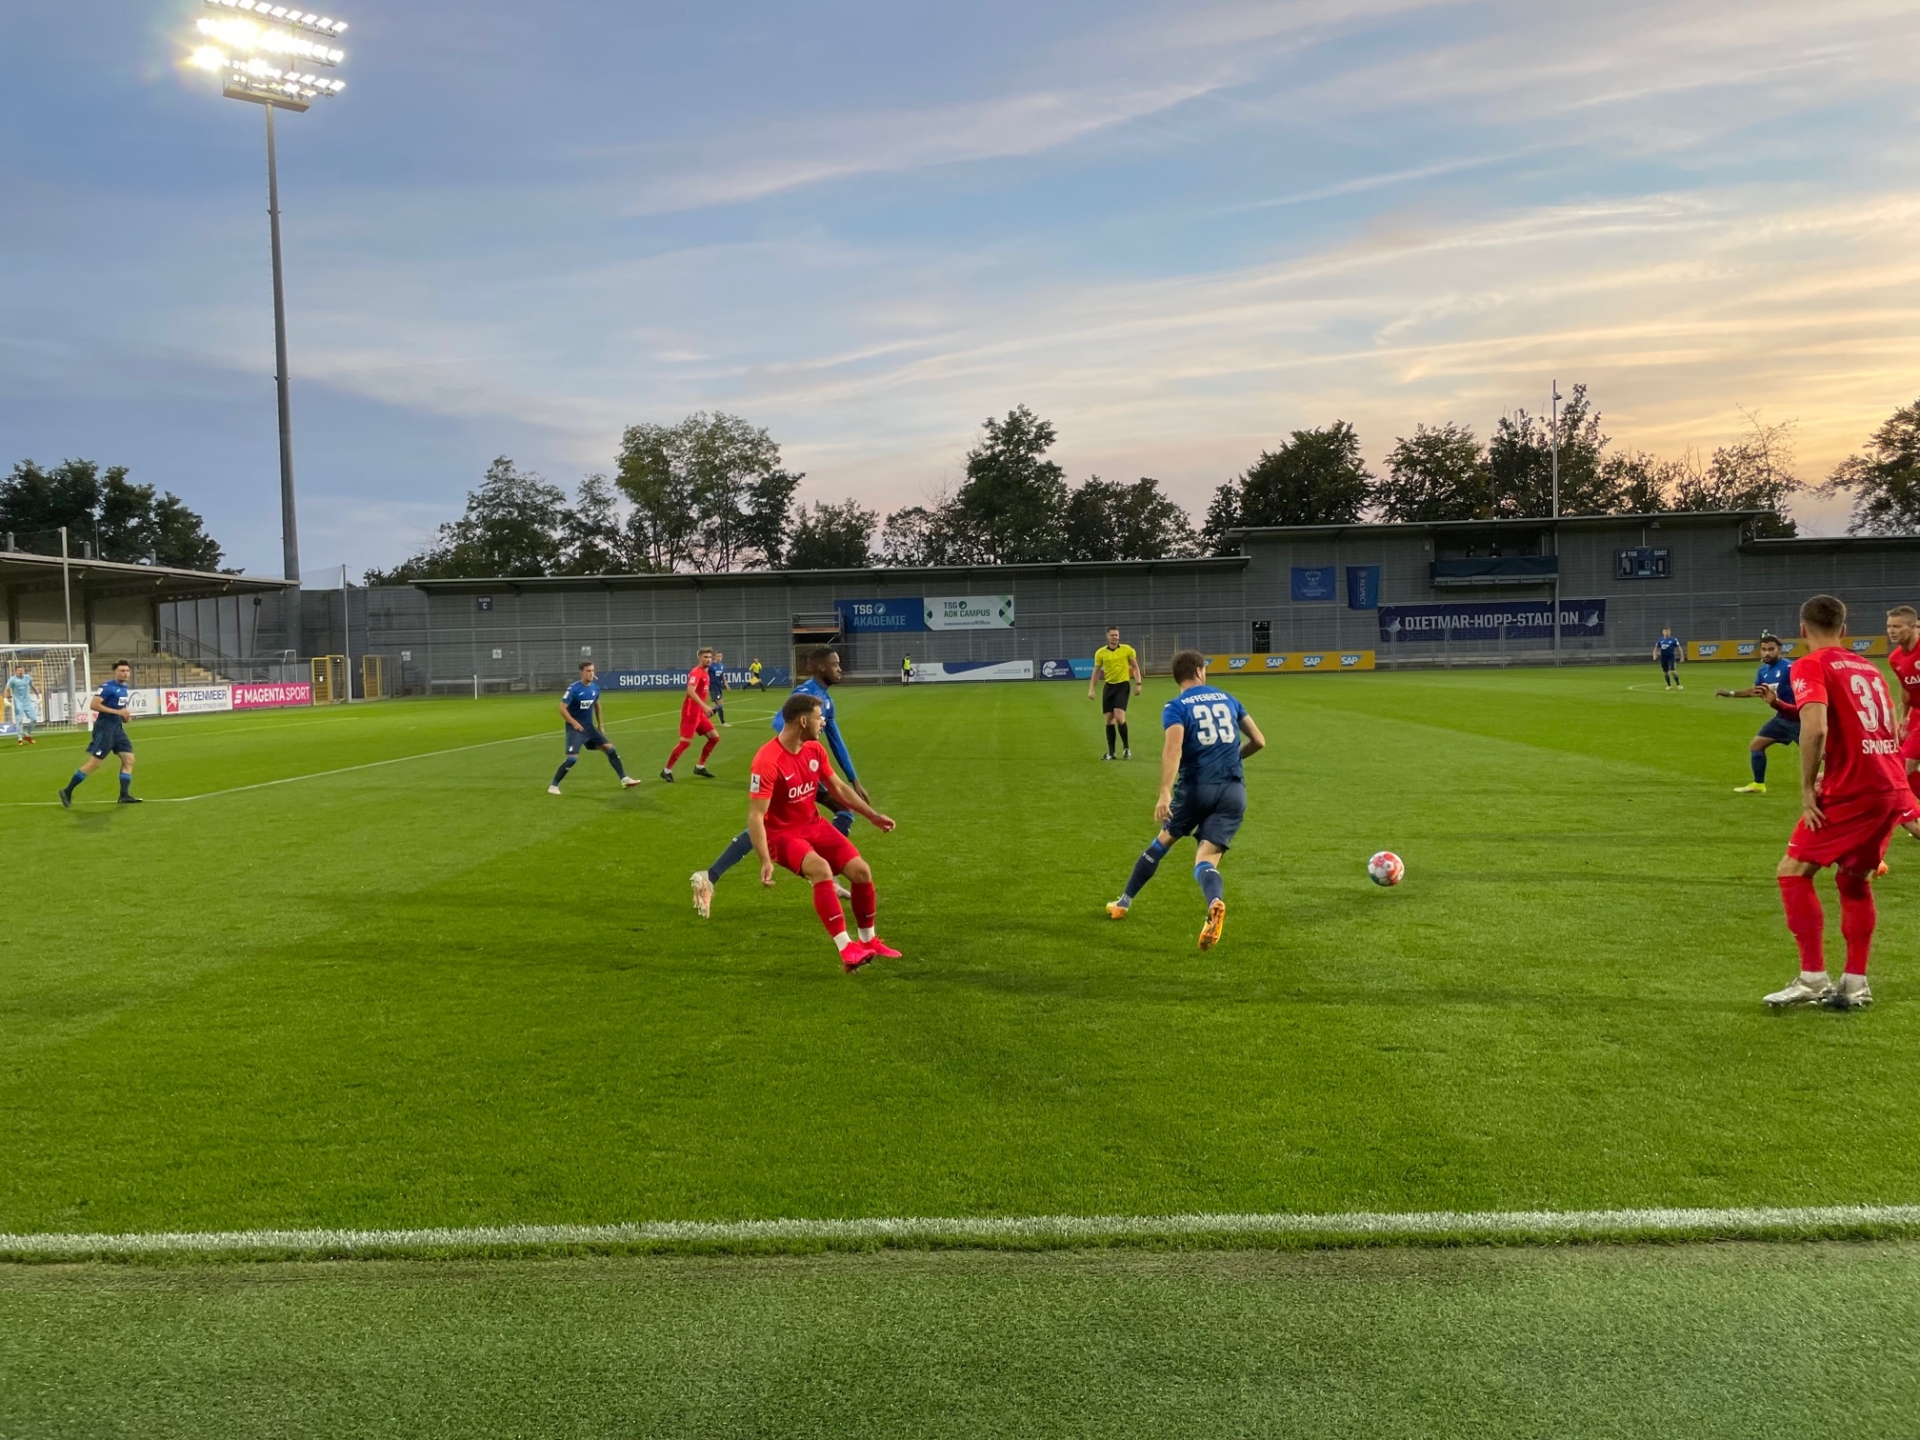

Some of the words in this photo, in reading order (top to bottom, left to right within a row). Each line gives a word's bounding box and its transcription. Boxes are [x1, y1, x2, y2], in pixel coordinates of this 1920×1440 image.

[853, 604, 873, 615] TSG
[943, 602, 958, 610] TSG
[960, 609, 991, 617] CAMPUS
[853, 615, 906, 627] AKADEMIE
[1405, 611, 1579, 631] DIETMAR-HOPP-STADON
[1699, 646, 1717, 655] SAP
[1738, 644, 1755, 654] SAP
[1852, 641, 1871, 651] SAP
[1229, 659, 1246, 669] SAP
[1266, 658, 1283, 667] SAP
[1303, 656, 1321, 666] SAP
[1341, 655, 1358, 665] SAP
[179, 689, 227, 702] PFITZENMEIER
[244, 688, 285, 704] MAGENTA
[285, 686, 310, 701] SPORT
[1850, 674, 1892, 733] 31
[1192, 703, 1235, 746] 33
[788, 781, 816, 799] OKAL
